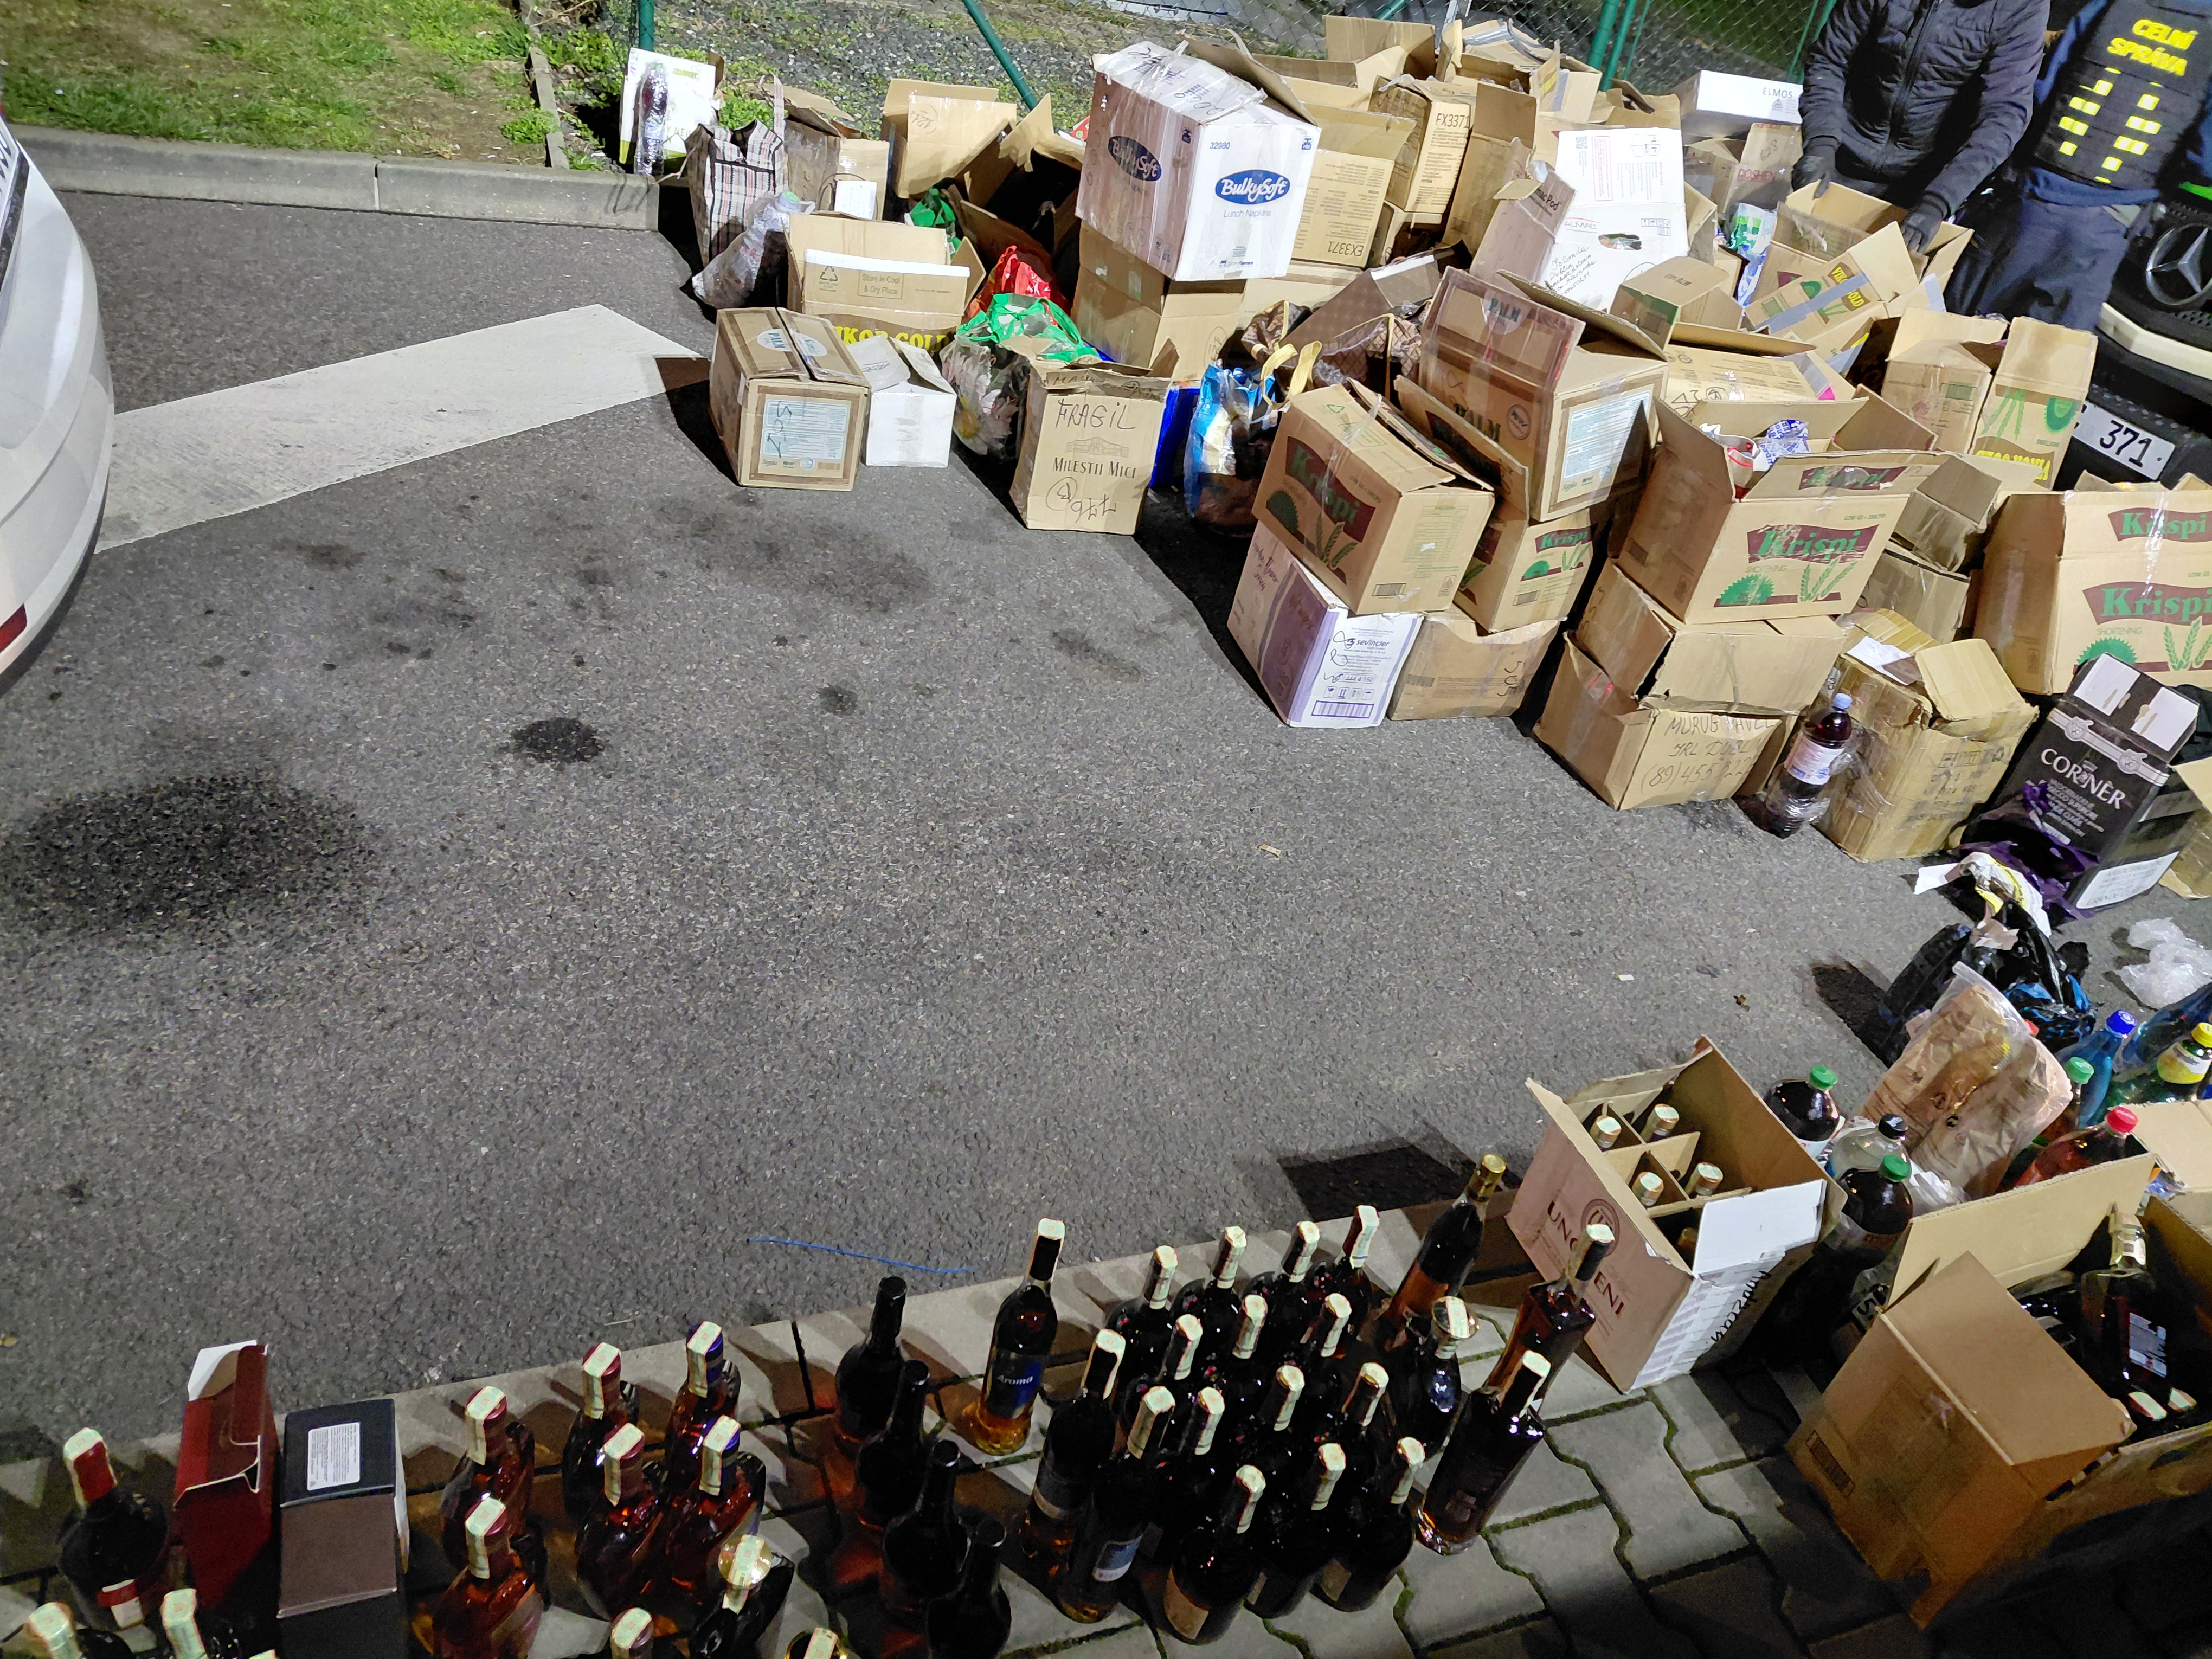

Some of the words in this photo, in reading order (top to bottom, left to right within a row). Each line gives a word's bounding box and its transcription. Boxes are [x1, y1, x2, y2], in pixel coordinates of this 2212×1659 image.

[2132, 18, 2199, 50] CELNÍ
[2106, 37, 2188, 76] SPRÁVA
[1763, 87, 1793, 99] ELMOS
[1221, 177, 1288, 203] BulkySoft
[1545, 194, 1560, 211] Pod
[1245, 209, 1272, 218] Napkins
[1327, 241, 1364, 256] EX3371
[862, 273, 878, 282] Store
[886, 275, 900, 283] Cool
[870, 286, 880, 295] Dry
[882, 286, 898, 294] Place
[1488, 298, 1521, 323] PALM
[2100, 419, 2153, 467] 371
[1108, 460, 1137, 479] MICI
[1539, 527, 1590, 550] Krispi
[1754, 530, 1861, 561] Krispi
[2099, 587, 2212, 622] Krispi
[997, 1375, 1033, 1385] Aroma
